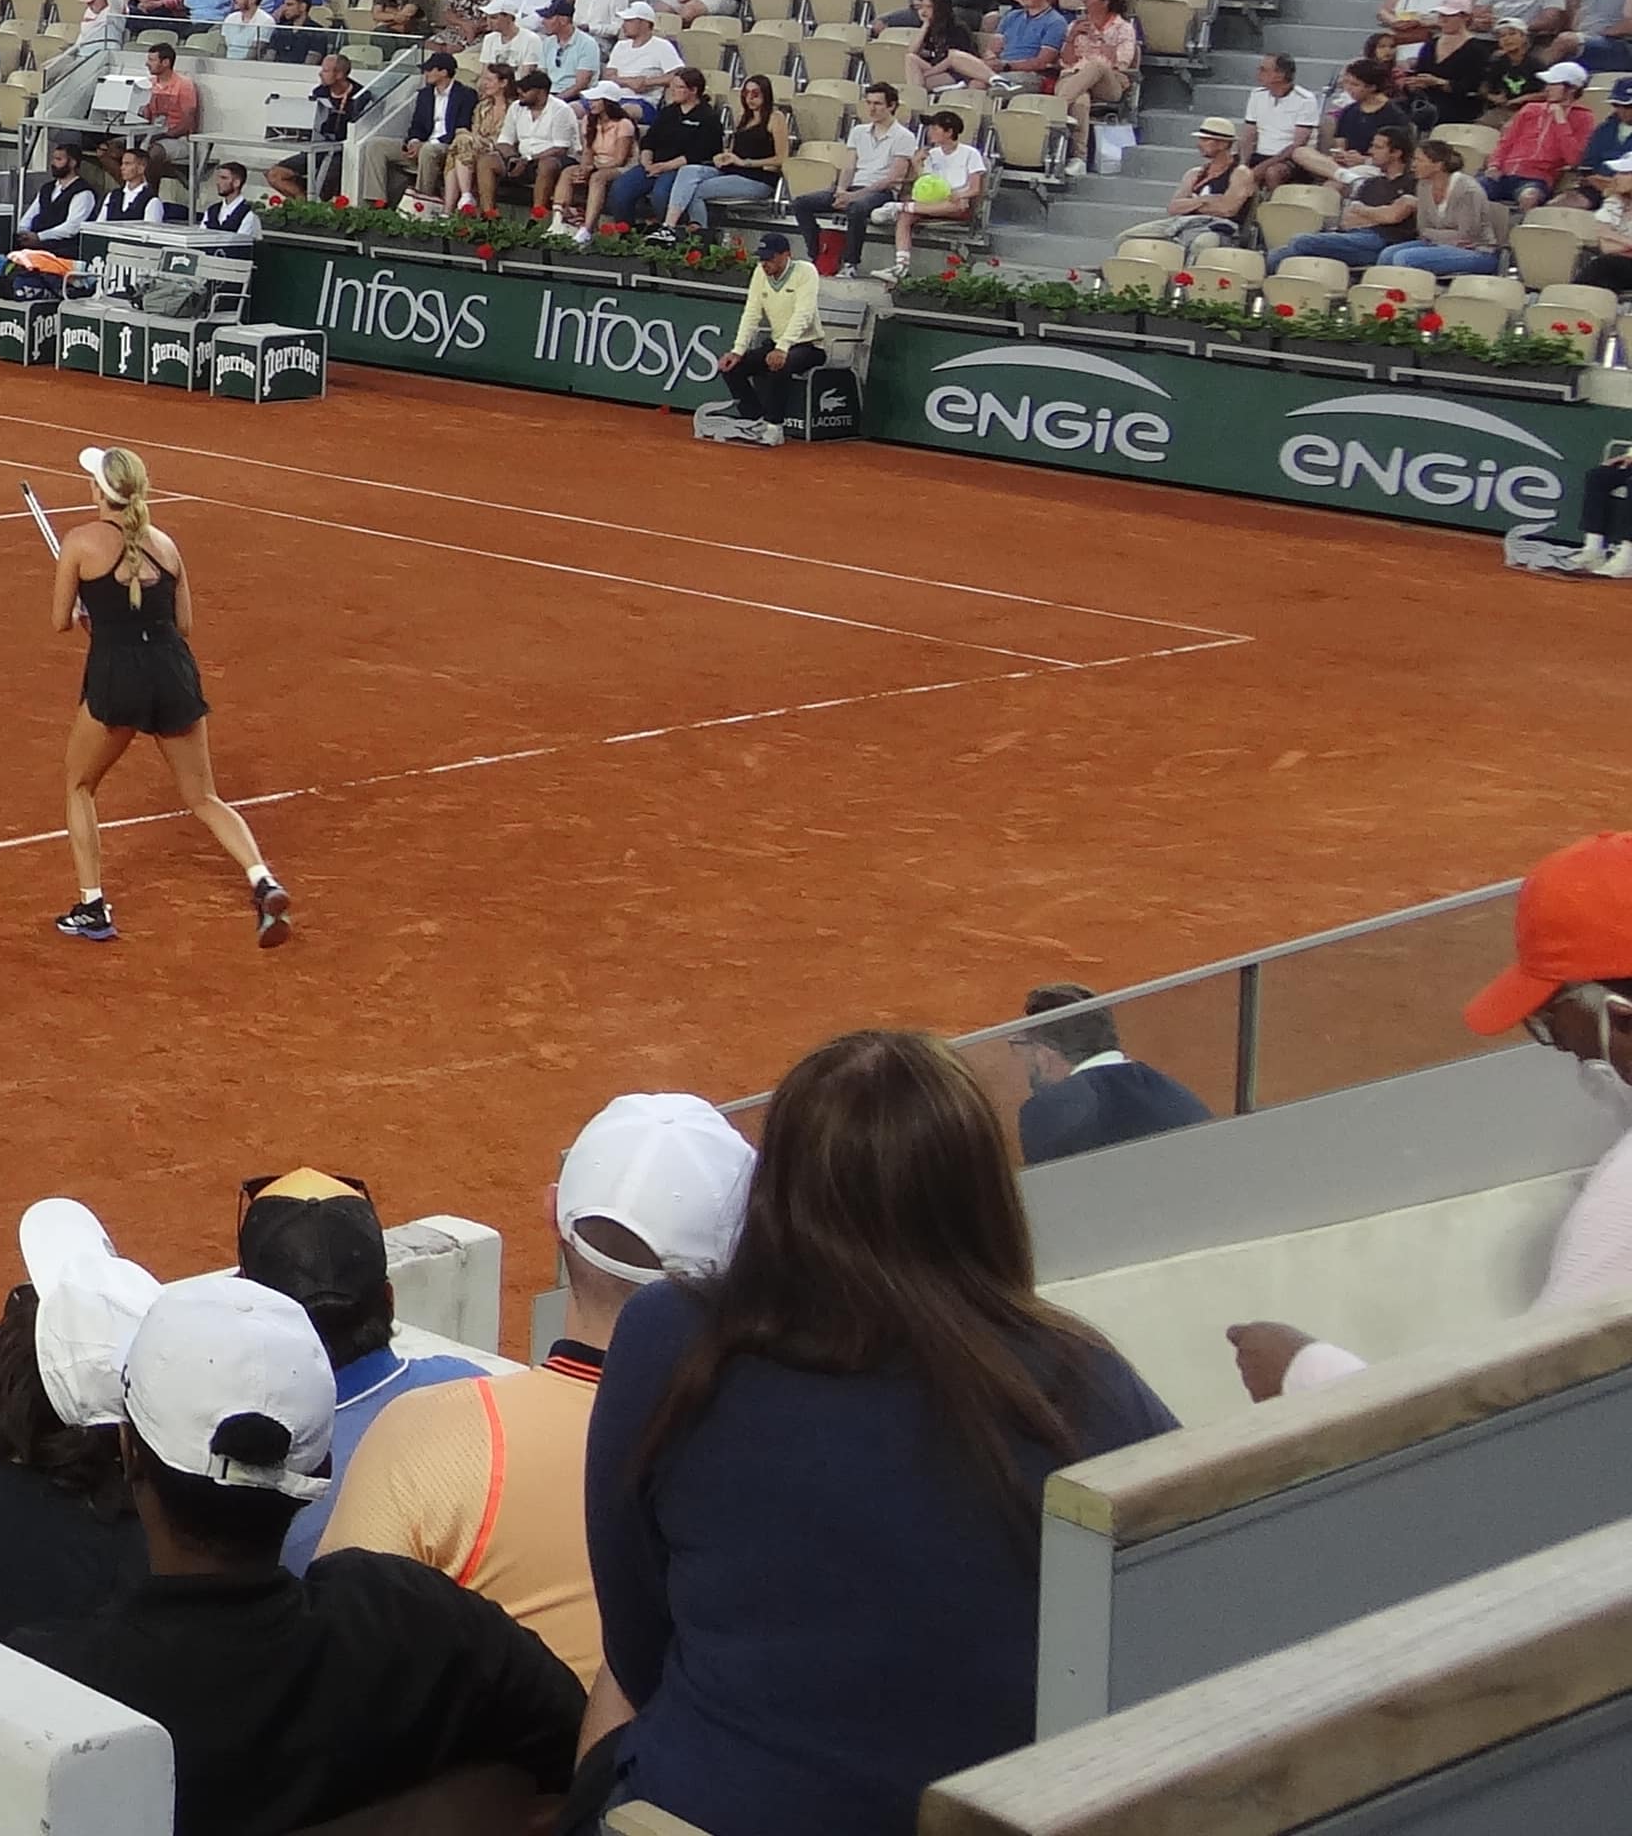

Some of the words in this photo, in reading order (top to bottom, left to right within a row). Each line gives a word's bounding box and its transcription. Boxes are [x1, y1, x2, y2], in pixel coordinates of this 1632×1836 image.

[316, 260, 487, 357] Infosys
[535, 290, 721, 391] Infosys
[811, 415, 852, 428] LACOSTE
